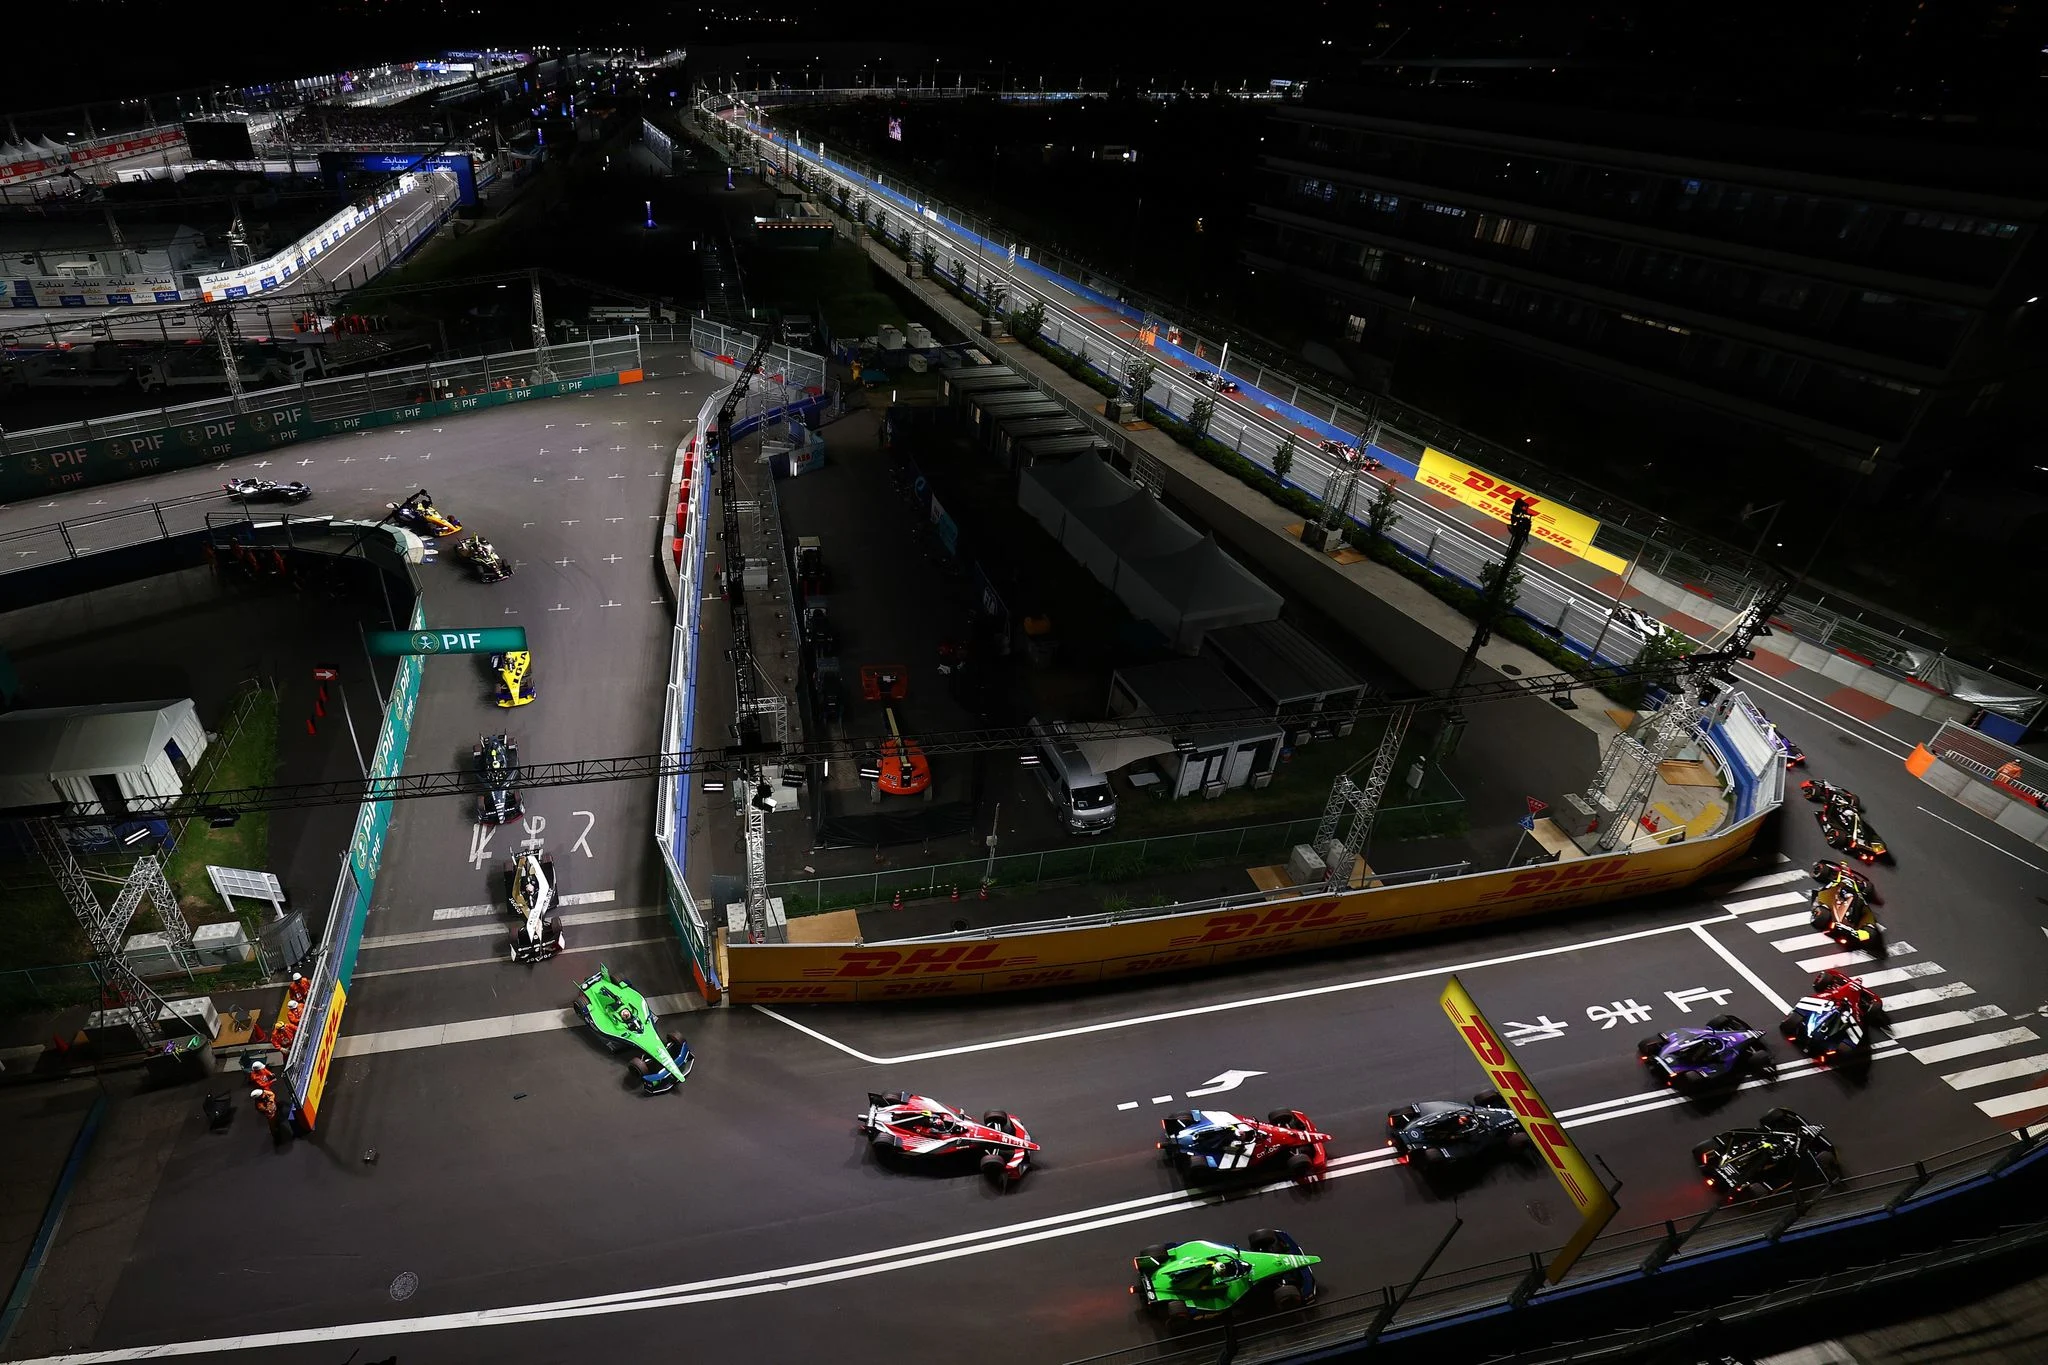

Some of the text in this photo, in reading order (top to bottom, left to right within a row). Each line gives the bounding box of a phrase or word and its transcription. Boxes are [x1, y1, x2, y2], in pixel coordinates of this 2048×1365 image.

[516, 379, 532, 395] PIF
[568, 371, 583, 386] PIF
[461, 391, 479, 408] PIF
[272, 408, 303, 430] PIF
[404, 407, 421, 422] PIF
[203, 420, 237, 442] PIF
[343, 417, 361, 434] PIF
[129, 434, 166, 455] PIF
[279, 429, 300, 444] PIF
[51, 448, 88, 469] PIF
[211, 442, 233, 458] PIF
[139, 456, 161, 472] PIF
[61, 471, 84, 486] PIF
[1426, 475, 1460, 496] DHL
[1463, 470, 1540, 517] DHL
[1536, 526, 1575, 549] DHL
[442, 632, 482, 651] PIF
[400, 659, 411, 700] PIF
[381, 719, 395, 765] PIF
[372, 832, 382, 863] PIF
[1501, 859, 1632, 898] DHL
[1198, 902, 1345, 943] DHL
[1440, 908, 1496, 927] DHL
[681, 904, 701, 953] PIF
[1339, 923, 1394, 942] DHL
[1238, 938, 1297, 955] DHL
[836, 943, 1006, 978] DHL
[1126, 954, 1190, 972] DHL
[1006, 968, 1084, 988] DHL
[755, 986, 837, 1000] DHL
[883, 981, 956, 997] DHL
[1503, 986, 1733, 1047] 止まれ
[317, 1009, 340, 1081] DHL
[1461, 1015, 1569, 1171] DHL
